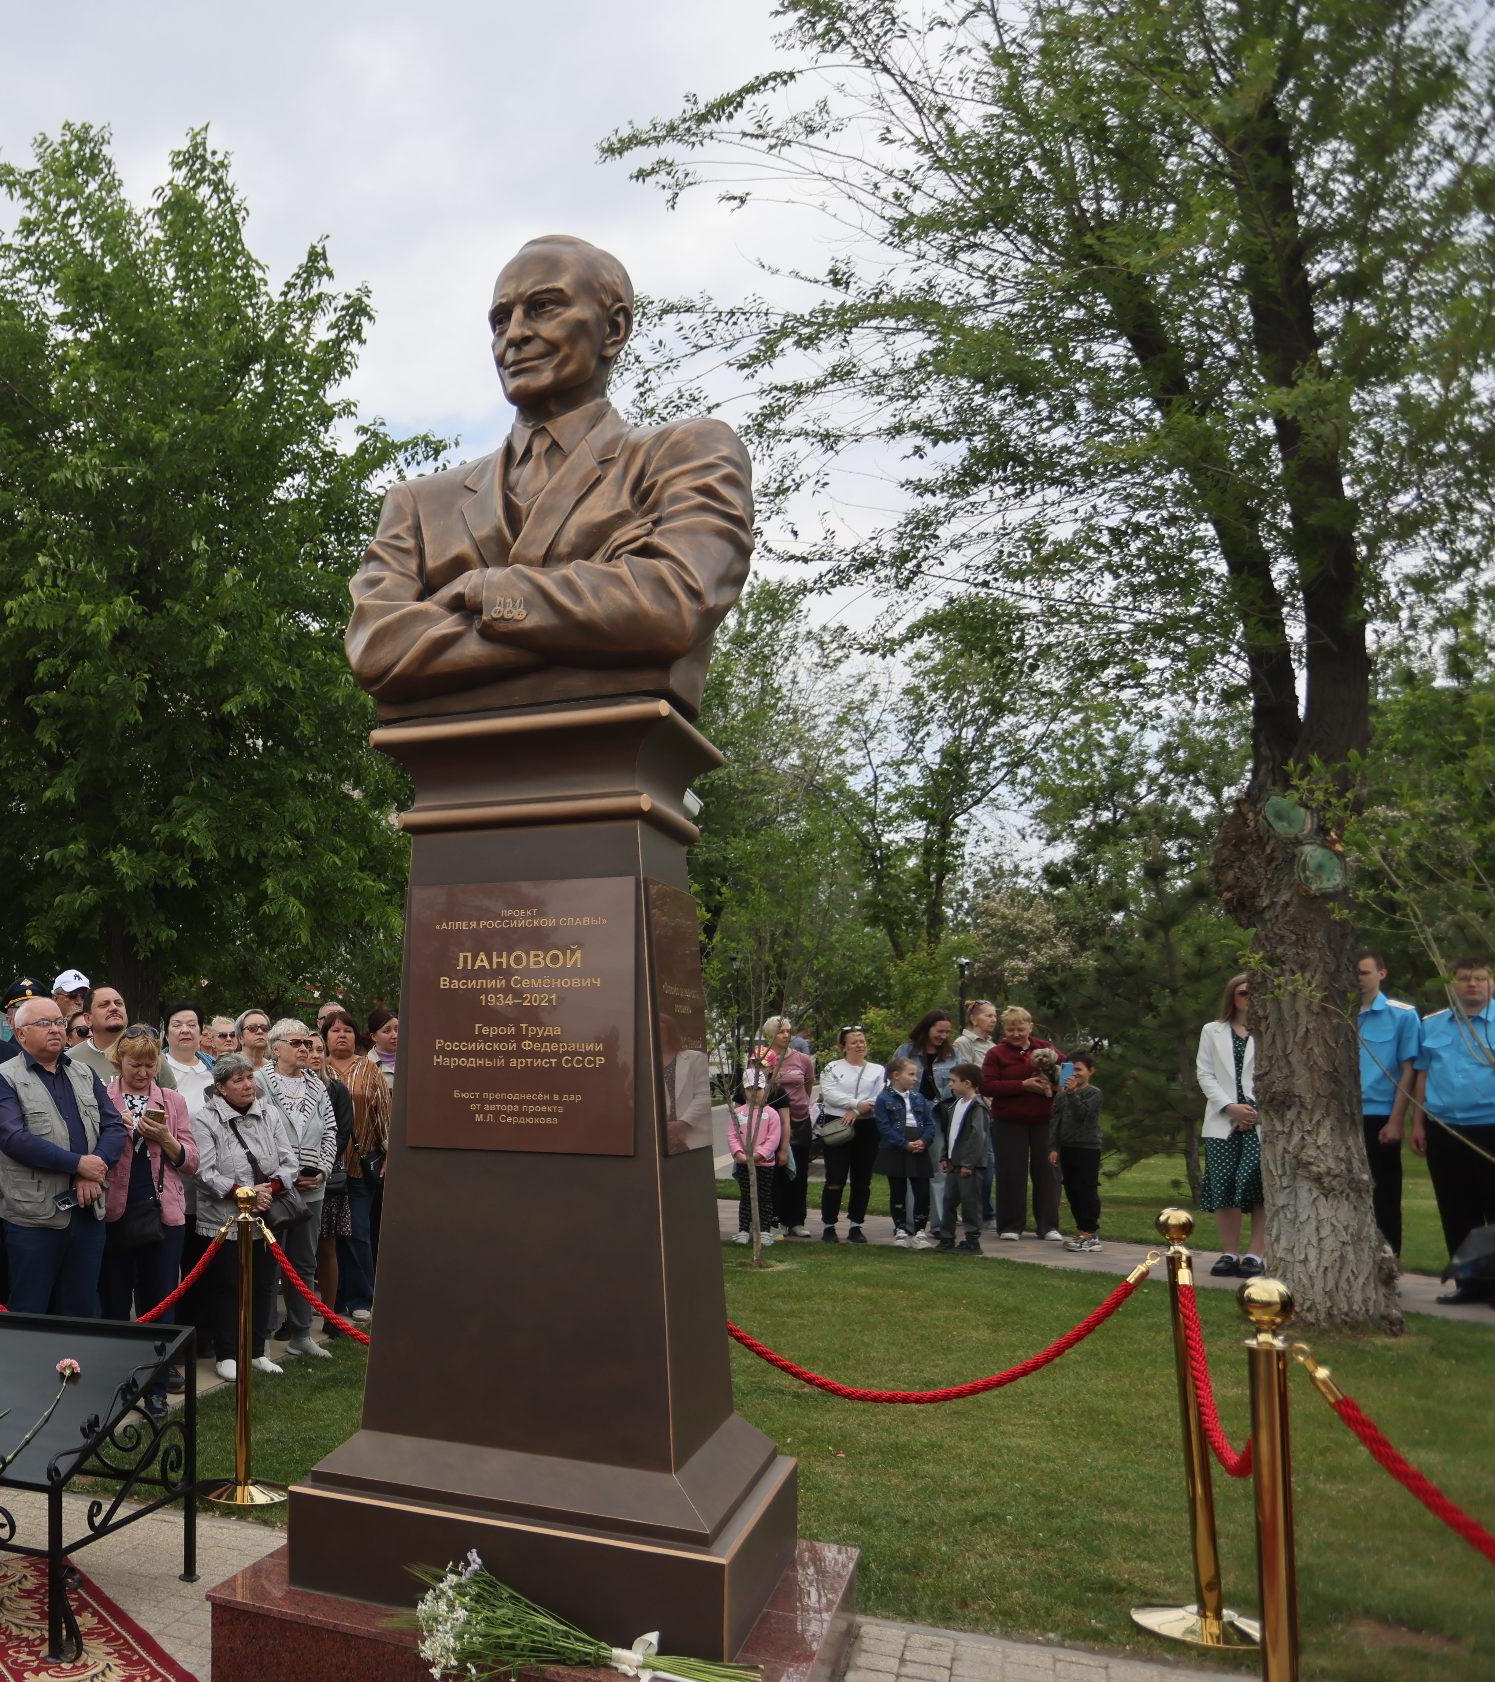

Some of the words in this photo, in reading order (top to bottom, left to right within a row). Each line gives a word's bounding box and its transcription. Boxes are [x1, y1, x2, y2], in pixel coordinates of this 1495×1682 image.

[501, 908, 538, 917] ПРОЕКТ
[436, 921, 477, 931] «АЛЛЕЯ
[480, 916, 555, 929] РОССИЙСКОЙ
[559, 917, 607, 926] СЛАВЫ»
[457, 945, 581, 970] ЛАНОВОЙ
[440, 976, 505, 989] Василий
[511, 975, 601, 988] Семёнович
[475, 1023, 515, 1037] Герой
[520, 1023, 561, 1037] Труда
[436, 1039, 517, 1051] Российской
[521, 1040, 603, 1053] Федерации
[433, 1055, 505, 1068] Народный
[509, 1057, 557, 1069] артист
[562, 1056, 605, 1068] СССР
[454, 1090, 480, 1099] Бюст
[483, 1091, 550, 1102] преподнесён
[562, 1094, 582, 1103] дар
[470, 1103, 481, 1111] от
[484, 1104, 519, 1113] автора
[522, 1105, 563, 1113] проекта
[499, 1115, 557, 1125] Сердюкова
